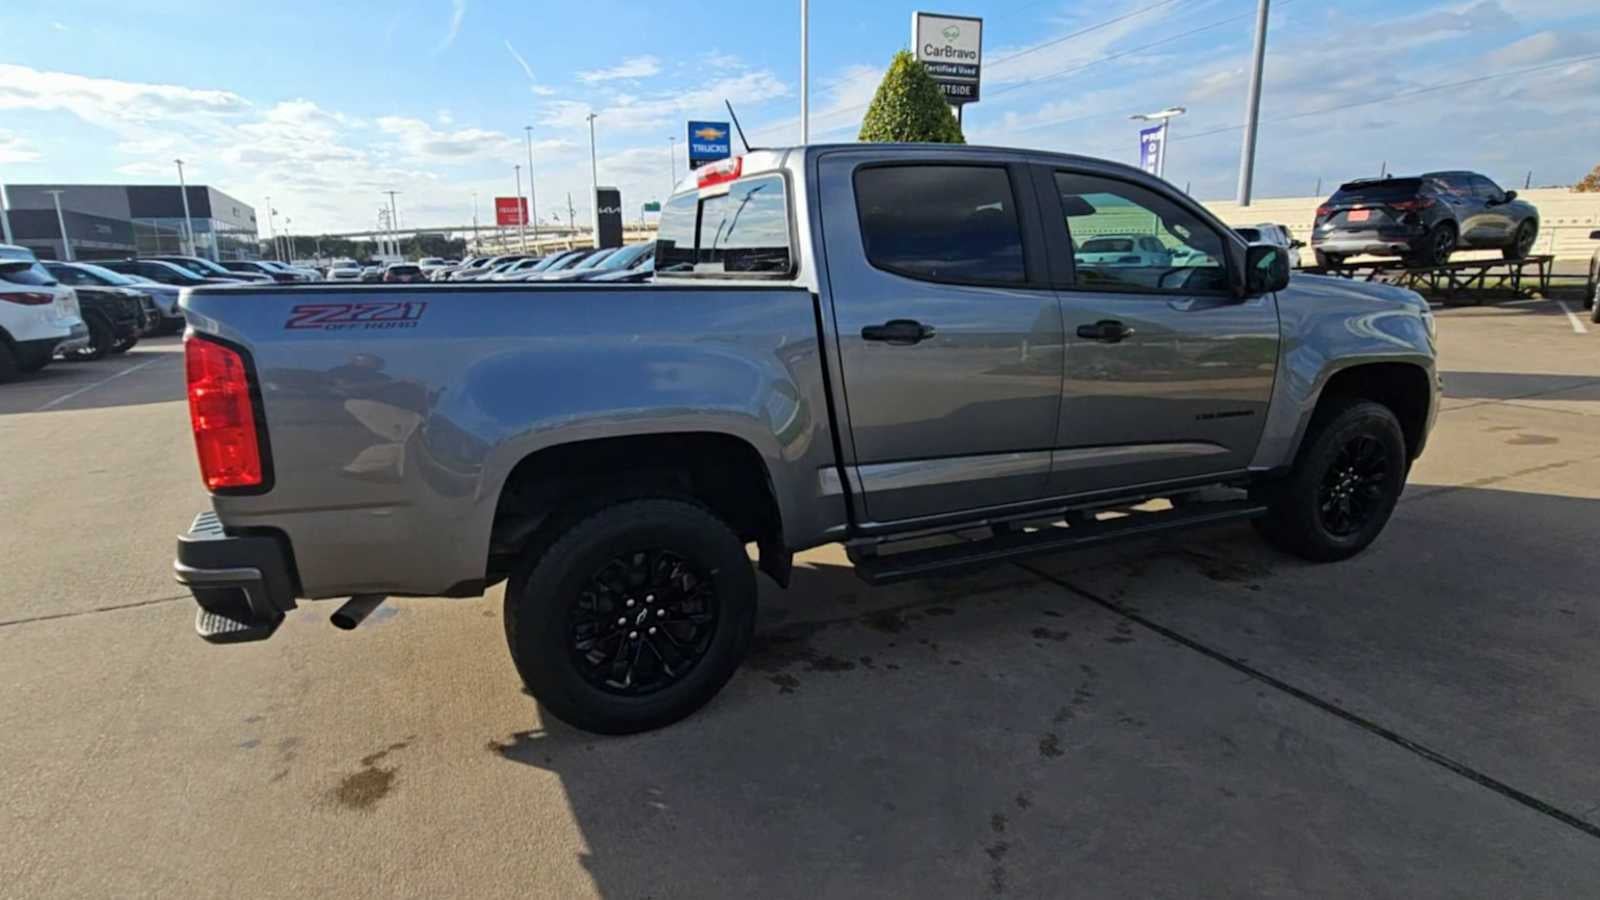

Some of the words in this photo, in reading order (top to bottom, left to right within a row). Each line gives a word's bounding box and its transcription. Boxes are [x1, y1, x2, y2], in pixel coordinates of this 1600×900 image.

[923, 43, 977, 60] CarBravo
[958, 65, 977, 75] Used
[692, 143, 729, 153] TRUCKS
[284, 301, 429, 330] Z71
